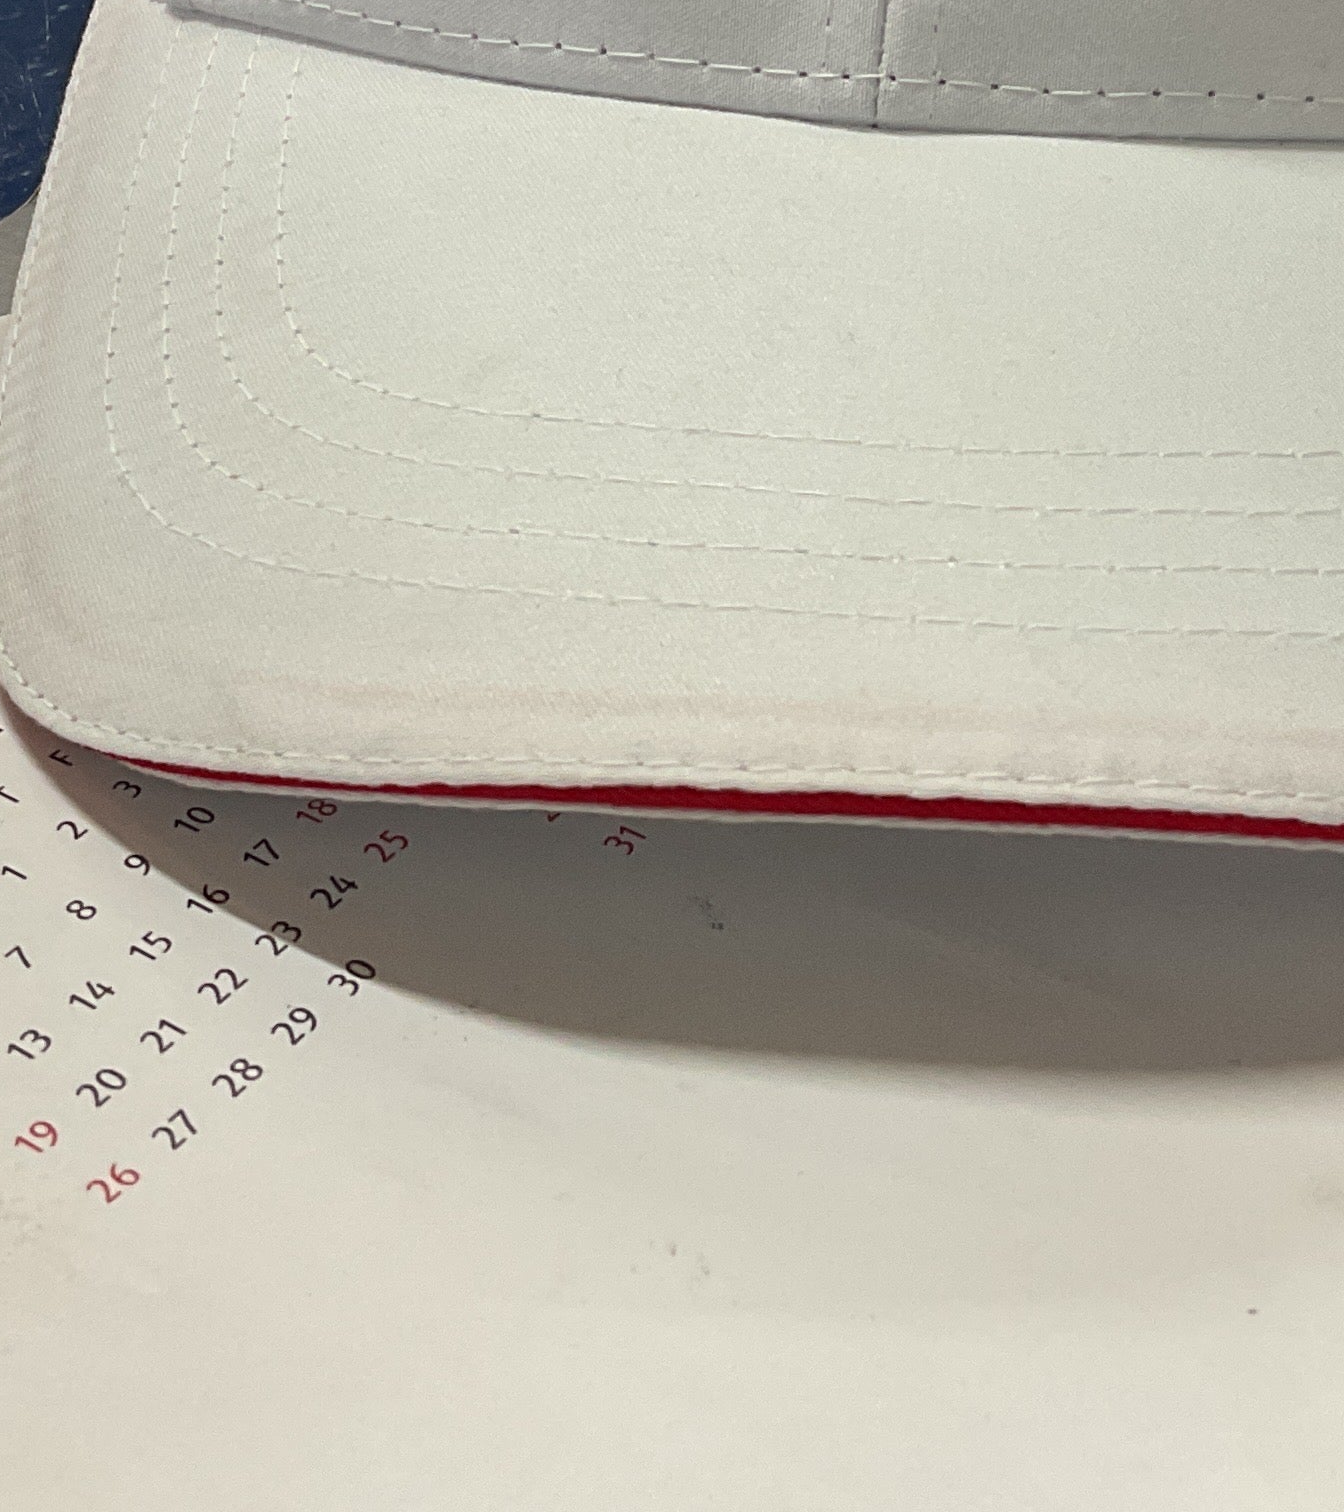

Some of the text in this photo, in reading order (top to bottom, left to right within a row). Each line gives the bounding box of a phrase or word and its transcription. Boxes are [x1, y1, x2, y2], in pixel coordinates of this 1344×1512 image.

[1, 779, 143, 880] 1 2 3
[49, 748, 74, 768] F
[4, 945, 31, 969] 7
[66, 900, 97, 920] 8
[123, 854, 150, 876] 9
[173, 805, 216, 834] 10
[602, 825, 647, 856] 31
[7, 1029, 52, 1060] 13
[69, 981, 115, 1010] 14
[129, 931, 172, 961] 15
[186, 884, 230, 913] 16
[243, 837, 280, 867] 17
[295, 797, 339, 825] 18
[15, 829, 409, 1153] 19 20 21 22 23 24 25
[86, 959, 376, 1204] 26 27 28 29 30
